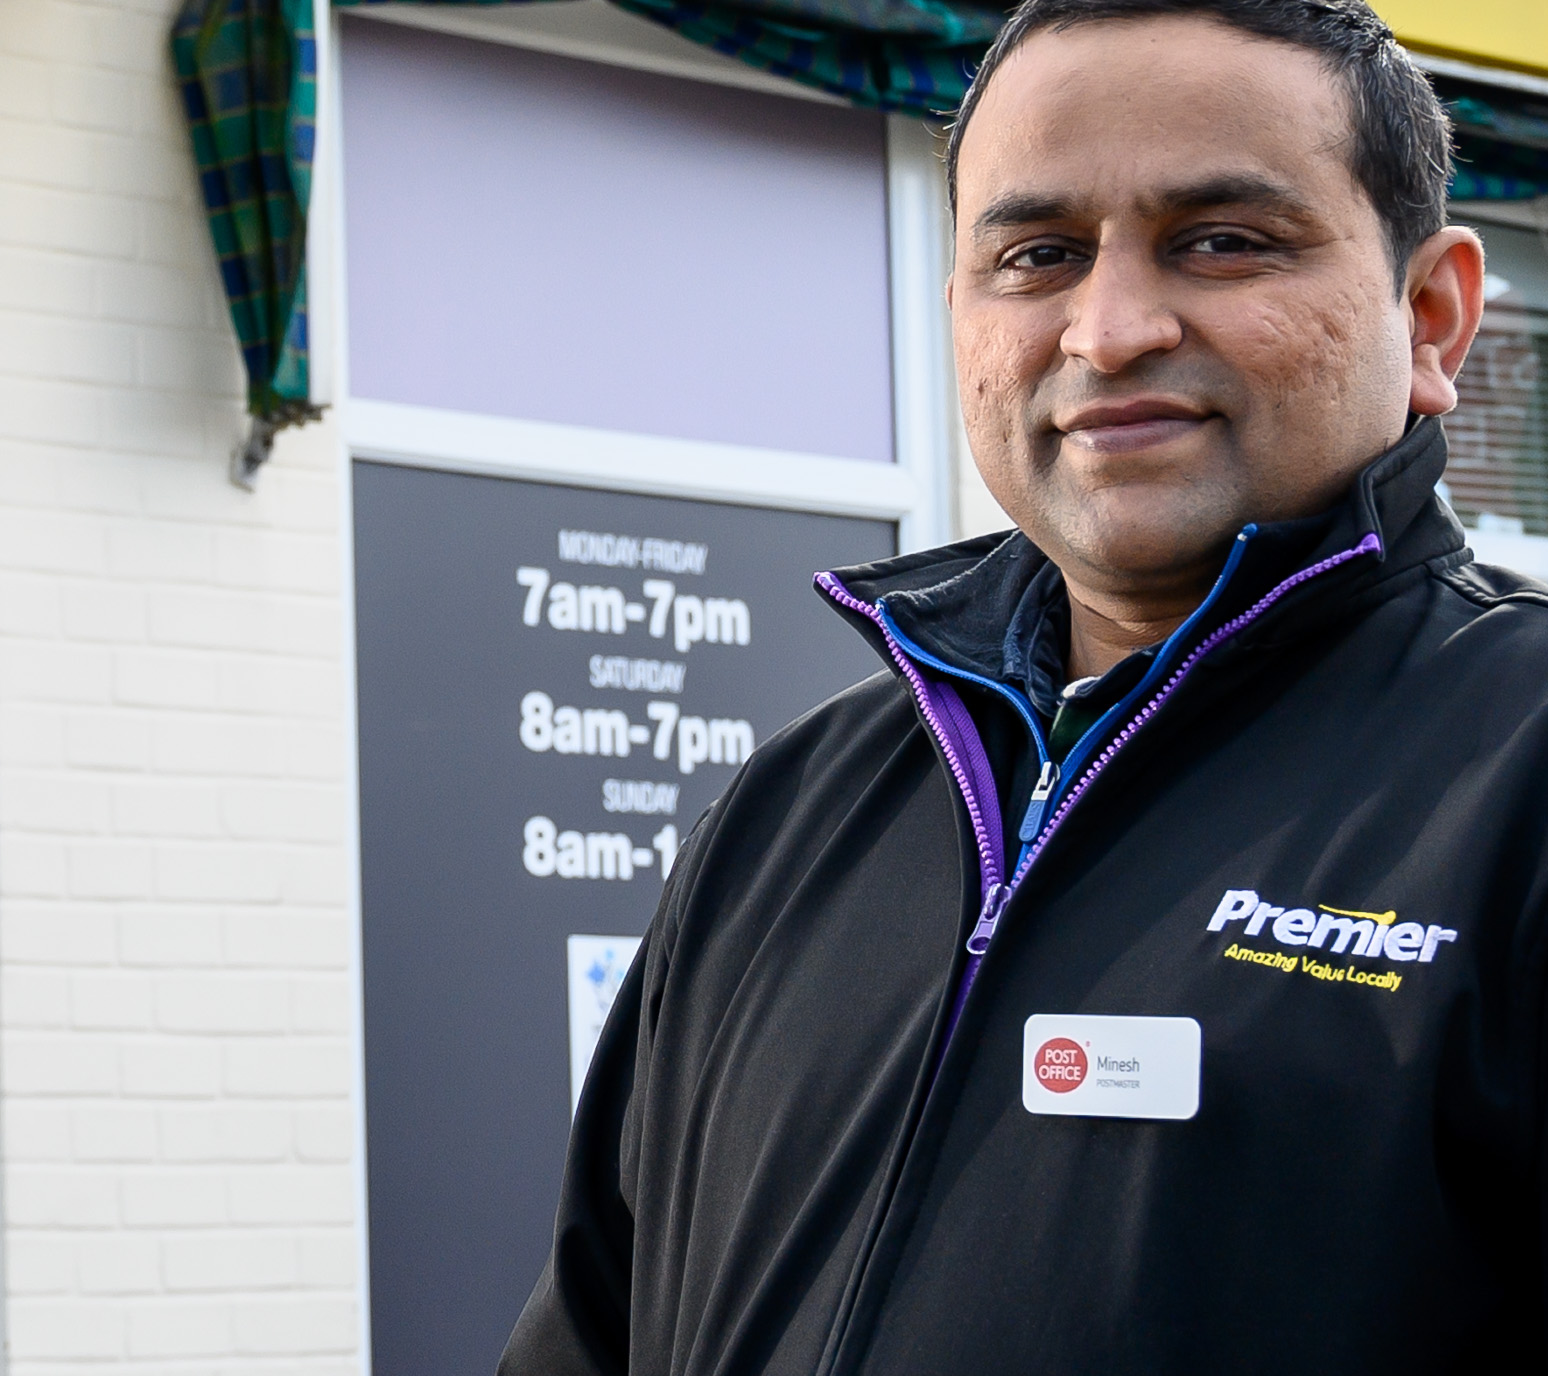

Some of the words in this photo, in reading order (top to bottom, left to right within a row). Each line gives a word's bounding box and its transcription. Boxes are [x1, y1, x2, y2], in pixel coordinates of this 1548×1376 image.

[558, 530, 708, 575] MONDAY-FRIDAY
[516, 567, 751, 652] 7am-7pm
[589, 655, 687, 694] SATURDAY
[518, 690, 755, 774] 8am-7pm
[602, 778, 682, 816] SUNDAY
[523, 816, 680, 881] 8am-1
[1206, 889, 1458, 962] Premier
[1224, 943, 1299, 972] Amazing
[1302, 956, 1346, 982] Value
[1346, 965, 1403, 992] Locally
[1038, 1064, 1082, 1081] OFFICE
[1044, 1048, 1078, 1064] POST
[1097, 1055, 1140, 1072] Minesh
[1096, 1078, 1141, 1089] POSTMASTER
